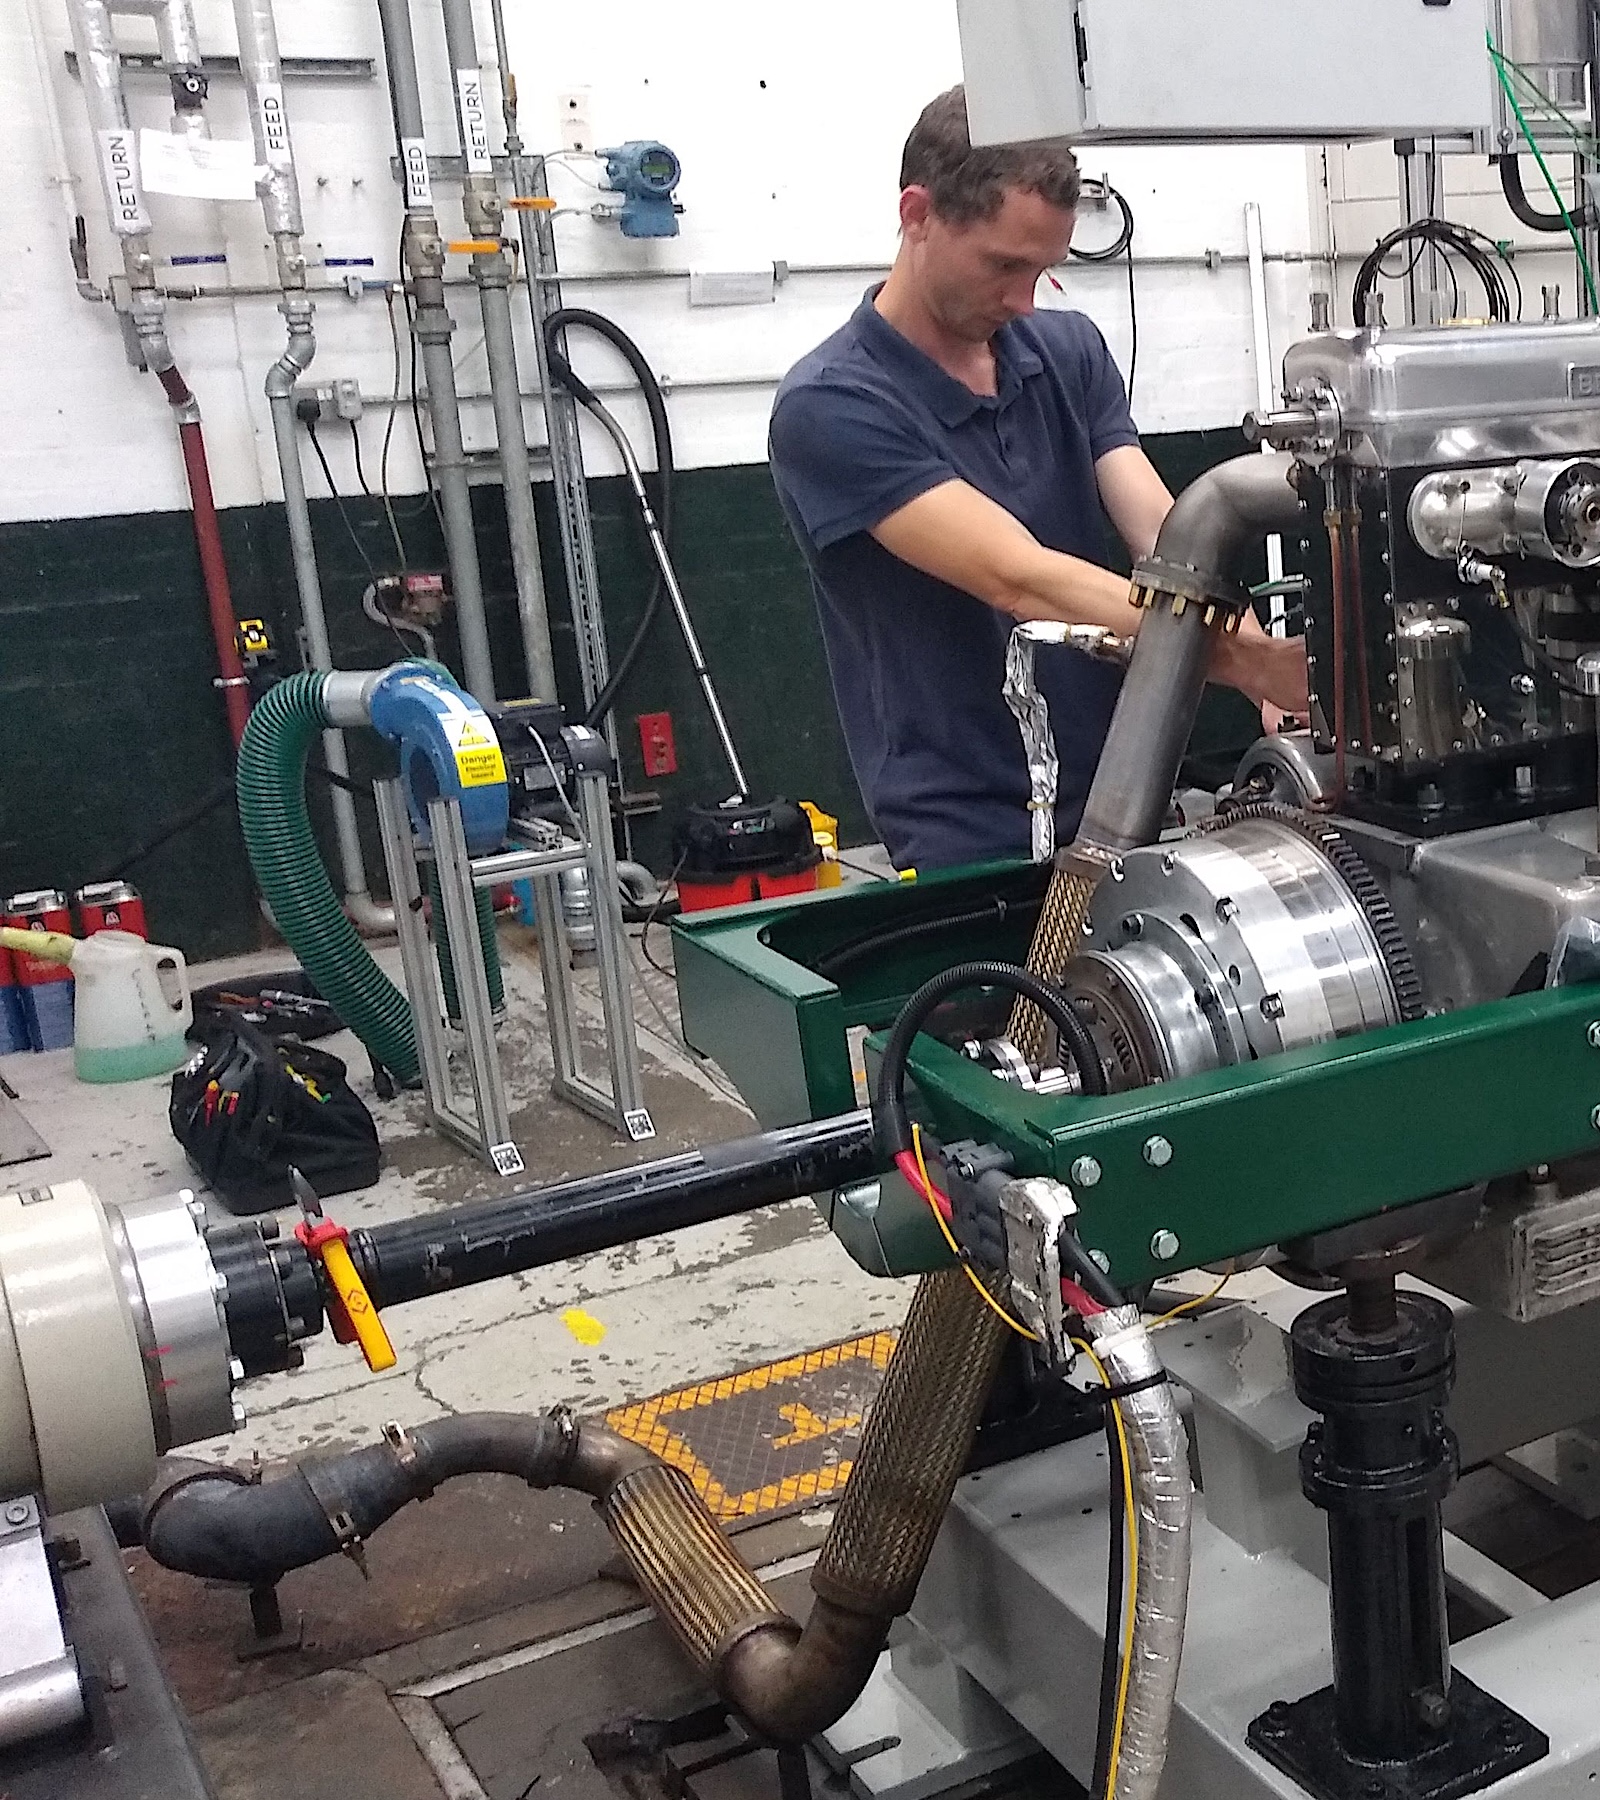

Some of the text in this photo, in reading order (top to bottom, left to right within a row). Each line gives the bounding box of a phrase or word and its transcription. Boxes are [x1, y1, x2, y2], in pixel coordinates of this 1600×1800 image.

[264, 97, 284, 149] FEED
[465, 83, 487, 160] RETURN
[109, 136, 139, 221] RETURN
[408, 147, 426, 197] FEED
[461, 754, 495, 764] Danger
